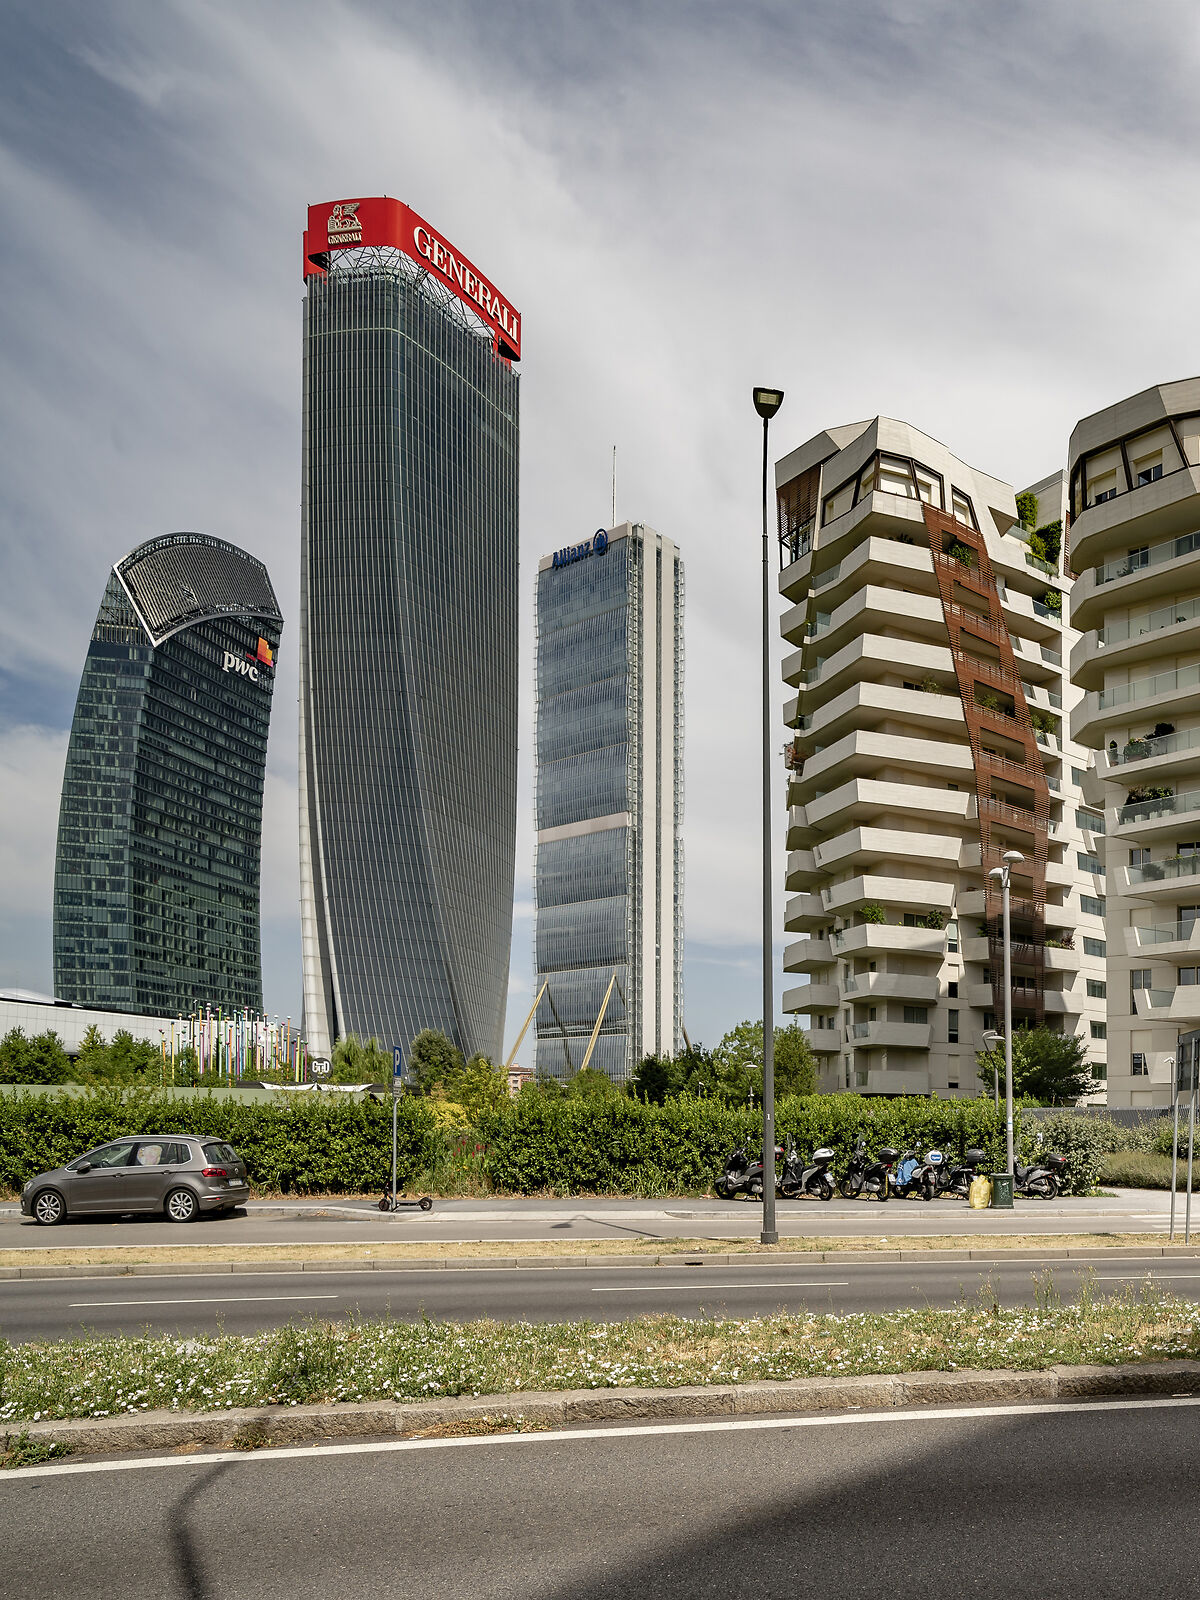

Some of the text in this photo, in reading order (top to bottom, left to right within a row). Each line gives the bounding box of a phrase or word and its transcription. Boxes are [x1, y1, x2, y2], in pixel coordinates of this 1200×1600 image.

[413, 226, 519, 344] GENERALI
[552, 541, 591, 568] Allianz
[222, 651, 258, 681] pwc
[395, 1049, 400, 1073] P
